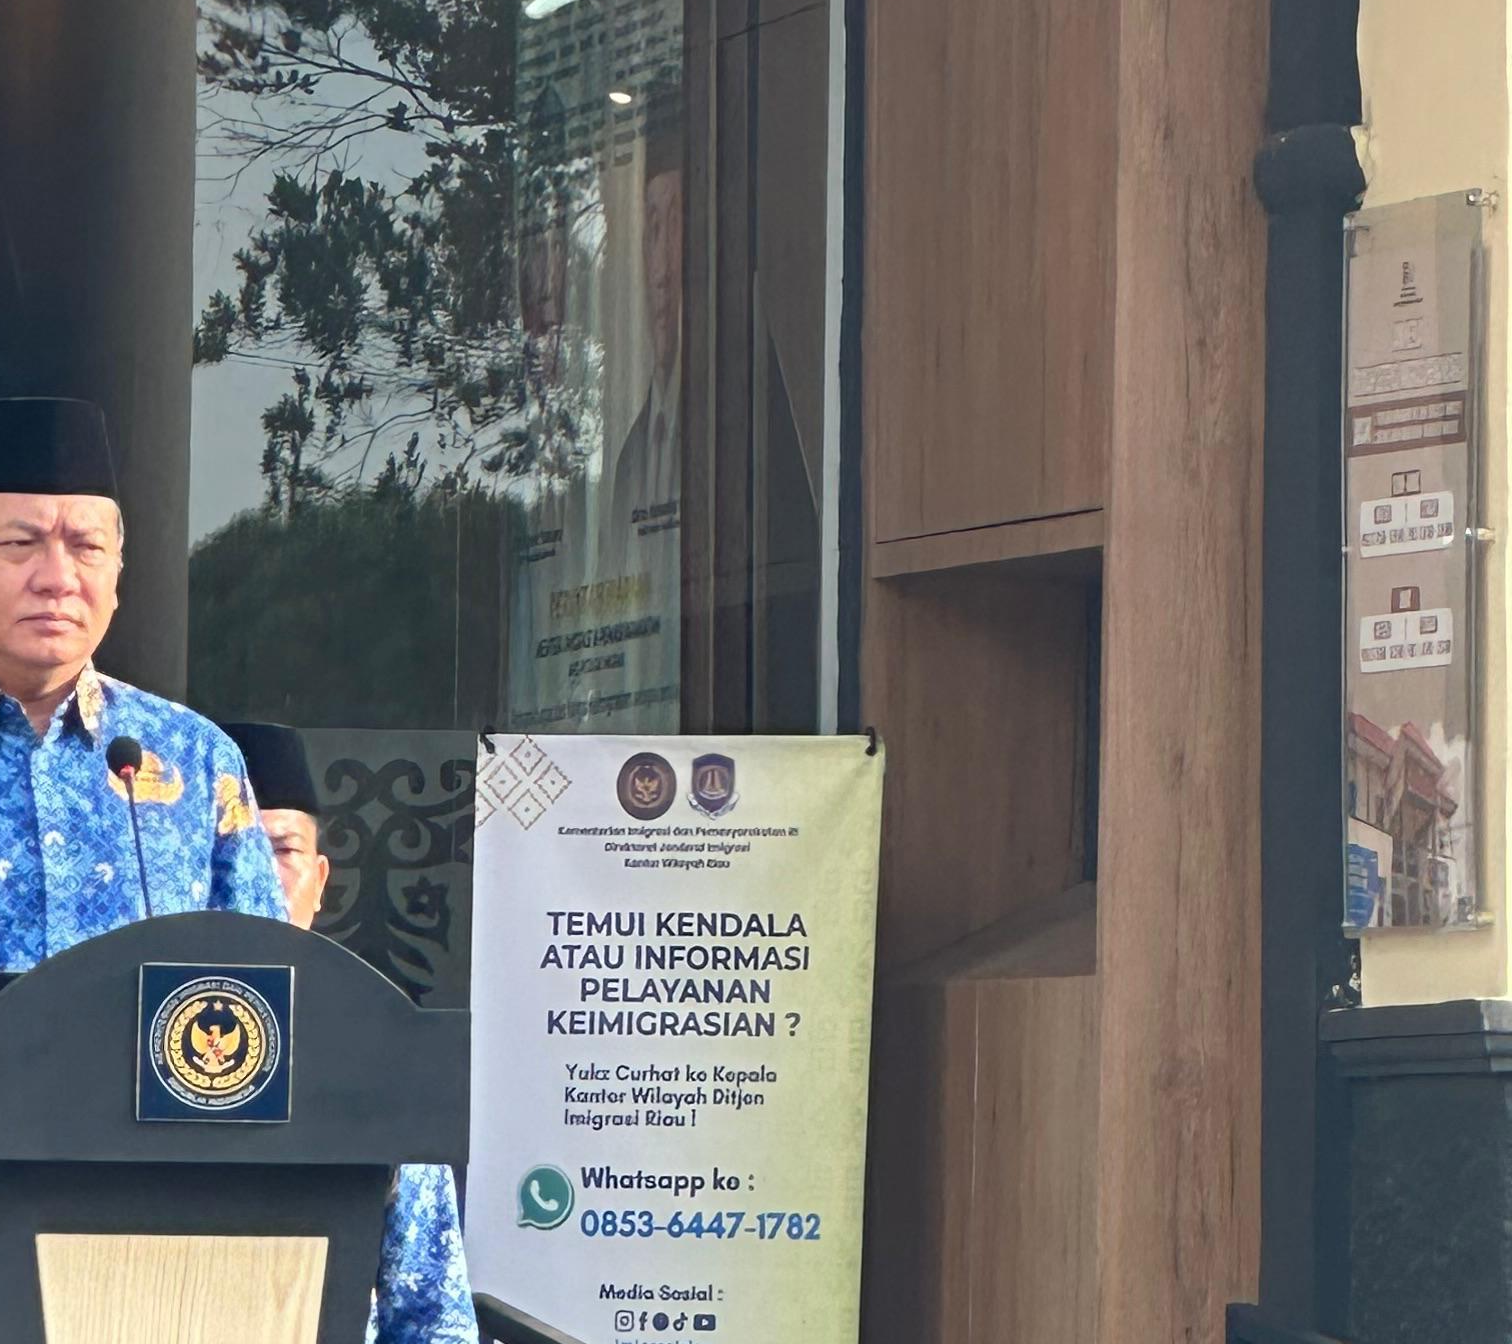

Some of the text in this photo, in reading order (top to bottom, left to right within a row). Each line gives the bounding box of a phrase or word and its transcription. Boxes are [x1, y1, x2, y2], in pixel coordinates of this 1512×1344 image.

[546, 911, 808, 938] TEMUI KENDALA
[539, 944, 810, 971] ATAU INFORMASI
[580, 977, 771, 1004] PELAYANAN
[547, 1009, 802, 1037] KEIMIGRASIAN ?
[615, 1064, 681, 1082] Curhat
[564, 1086, 627, 1103] Kantor
[631, 1086, 707, 1110] Wilayah
[564, 1109, 639, 1131] Imigrasi
[645, 1110, 686, 1127] Riau
[580, 1166, 705, 1198] Whatsapp
[579, 1209, 822, 1241] 0853-6447-1782
[599, 1284, 655, 1302] Media
[658, 1284, 713, 1302] Sosial
